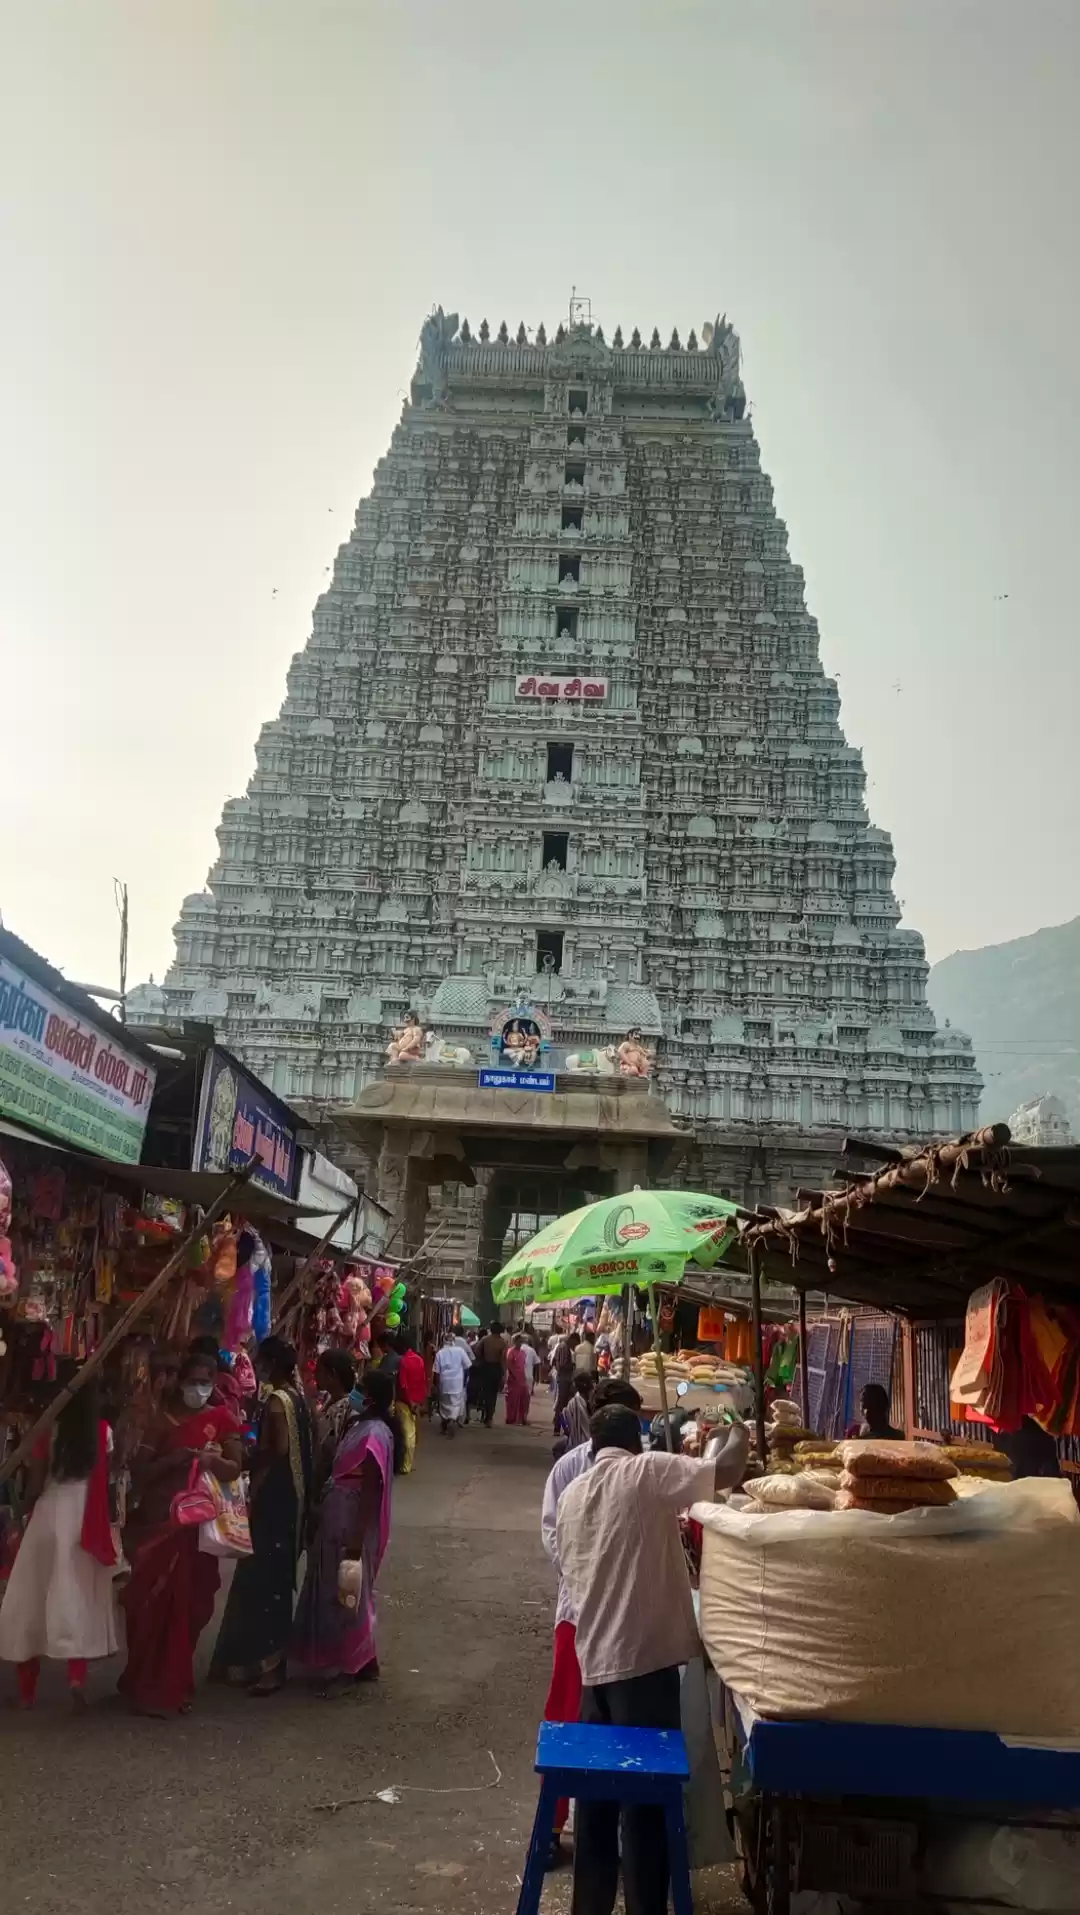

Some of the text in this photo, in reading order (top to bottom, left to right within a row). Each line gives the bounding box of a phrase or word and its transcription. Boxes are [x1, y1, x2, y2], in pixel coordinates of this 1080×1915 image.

[518, 677, 605, 698] சிவ சிவ
[589, 1259, 639, 1276] BEDROCK
